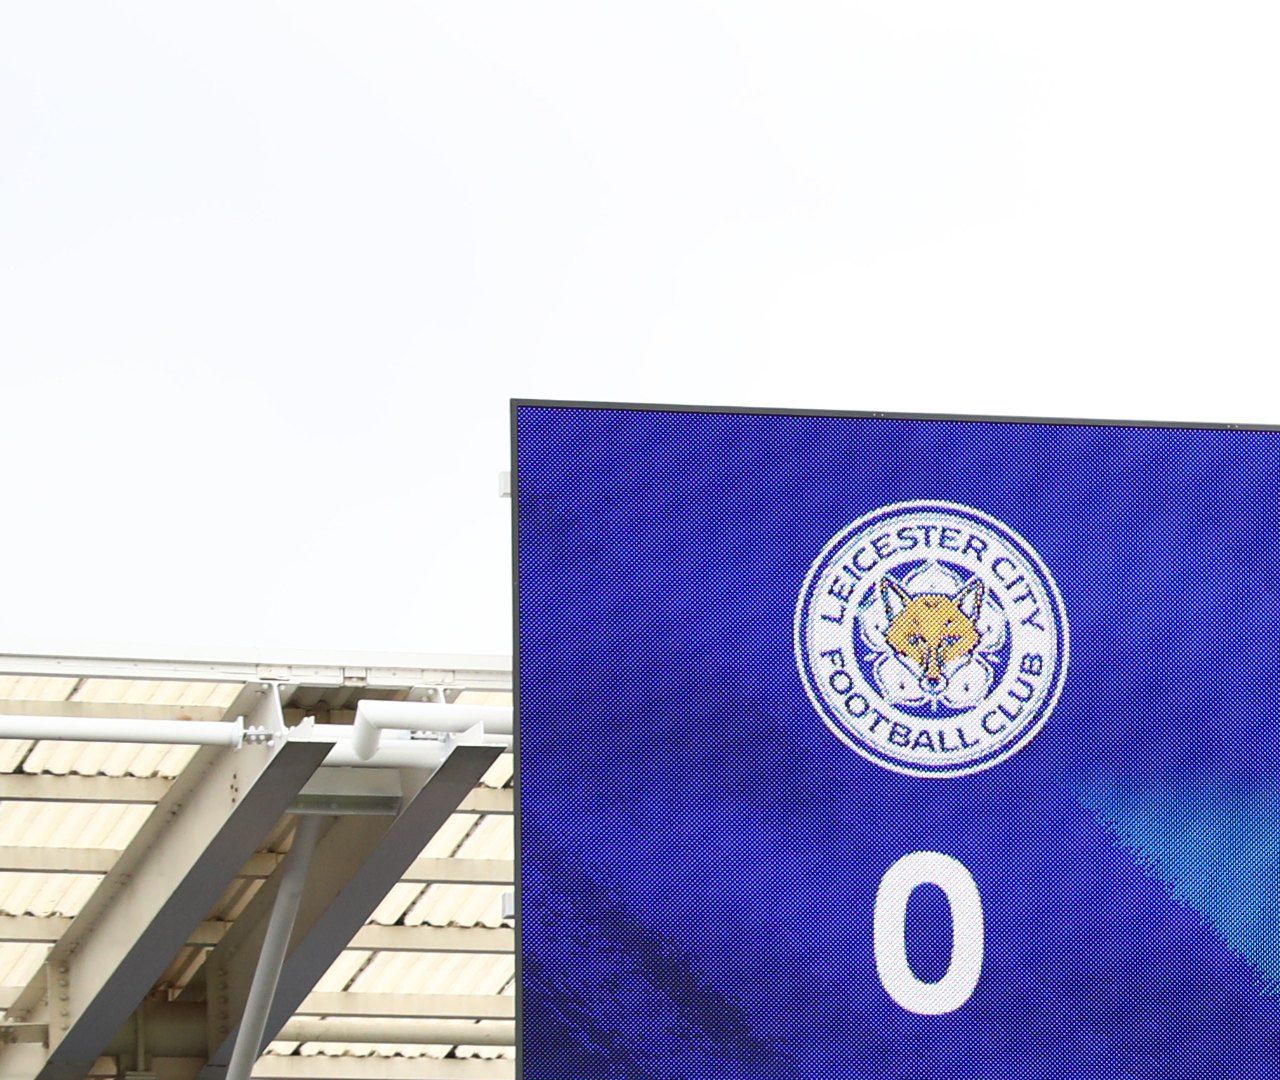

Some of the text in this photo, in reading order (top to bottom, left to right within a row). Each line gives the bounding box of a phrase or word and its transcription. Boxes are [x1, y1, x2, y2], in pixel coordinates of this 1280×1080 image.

[820, 524, 1045, 632] LEICESTER CITY
[820, 647, 1044, 752] FOOTBALL CLUB
[873, 850, 984, 1016] 0
